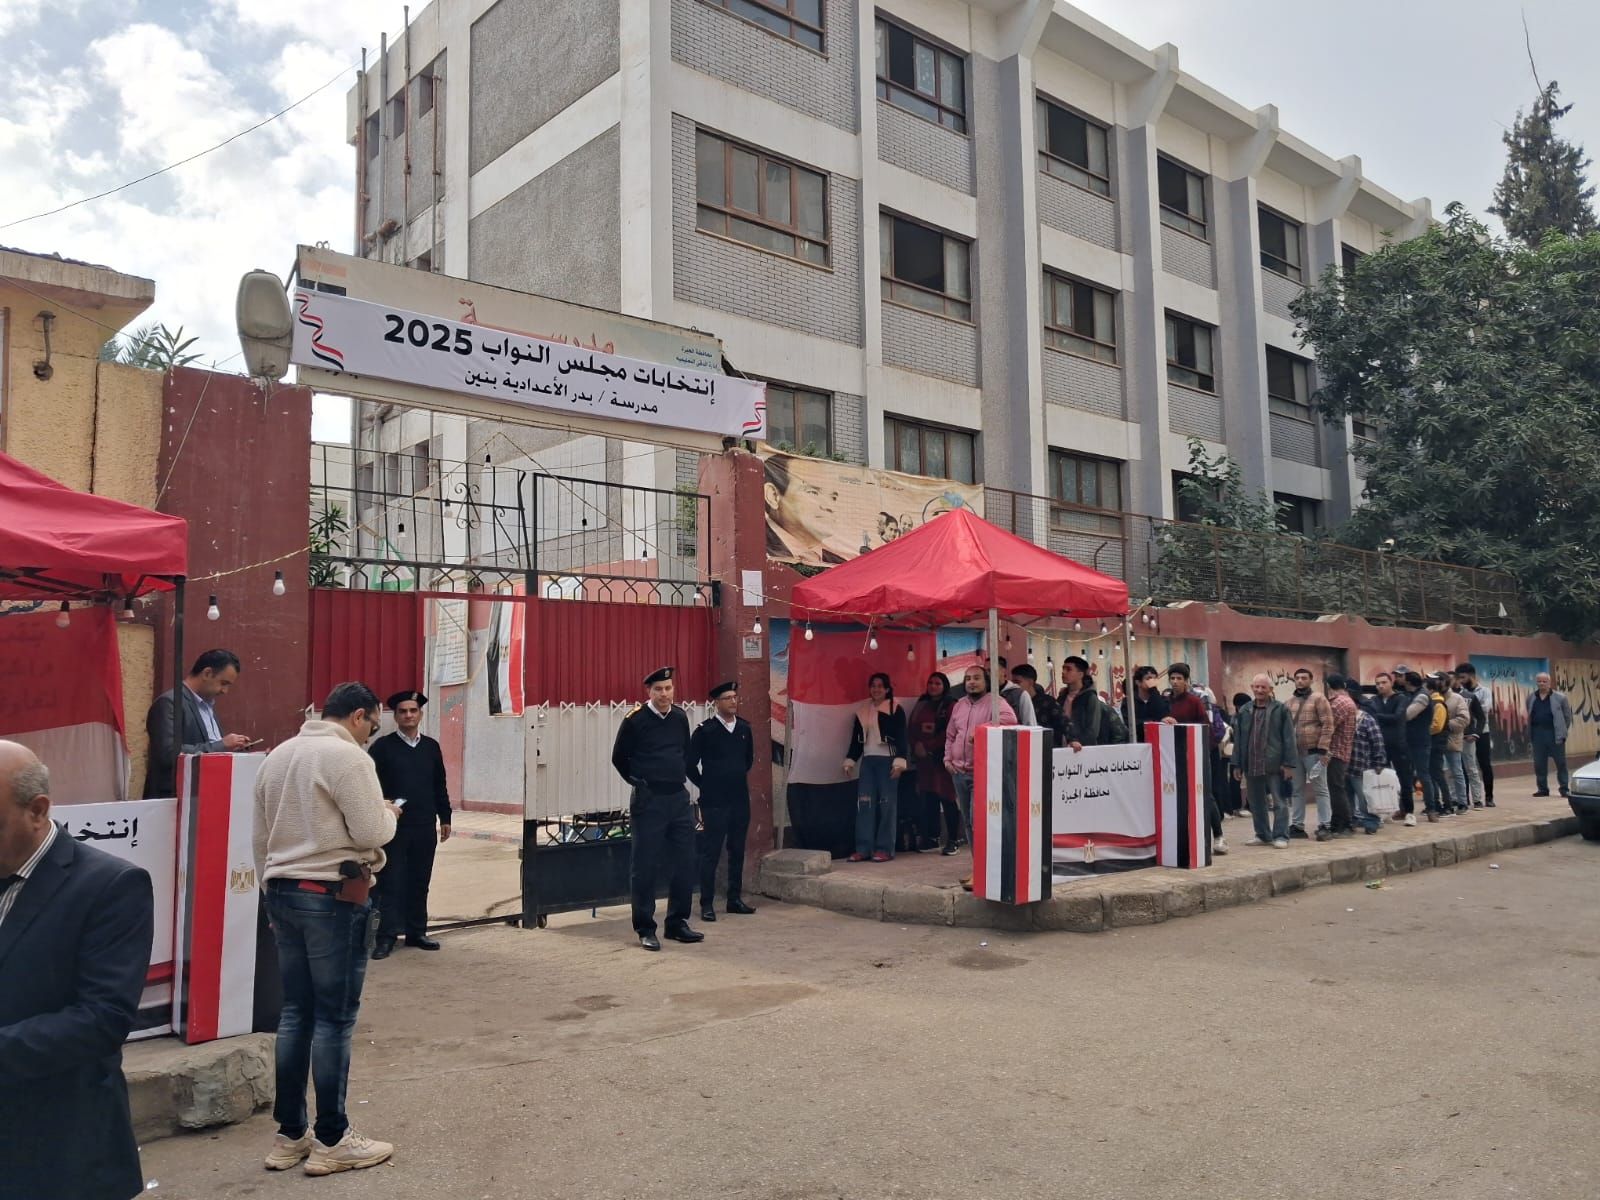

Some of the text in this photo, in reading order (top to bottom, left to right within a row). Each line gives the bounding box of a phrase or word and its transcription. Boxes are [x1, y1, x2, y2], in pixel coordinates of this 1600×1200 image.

[384, 314, 715, 405] إنتخابات مجلس النواب 2025
[464, 370, 658, 413] مدرسة / بدر الأعدادية بنين
[1058, 763, 1082, 780] النواب
[1085, 762, 1108, 778] مجلس
[1061, 786, 1110, 804] محافظة الجيزة
[65, 817, 138, 848] إنتخا
